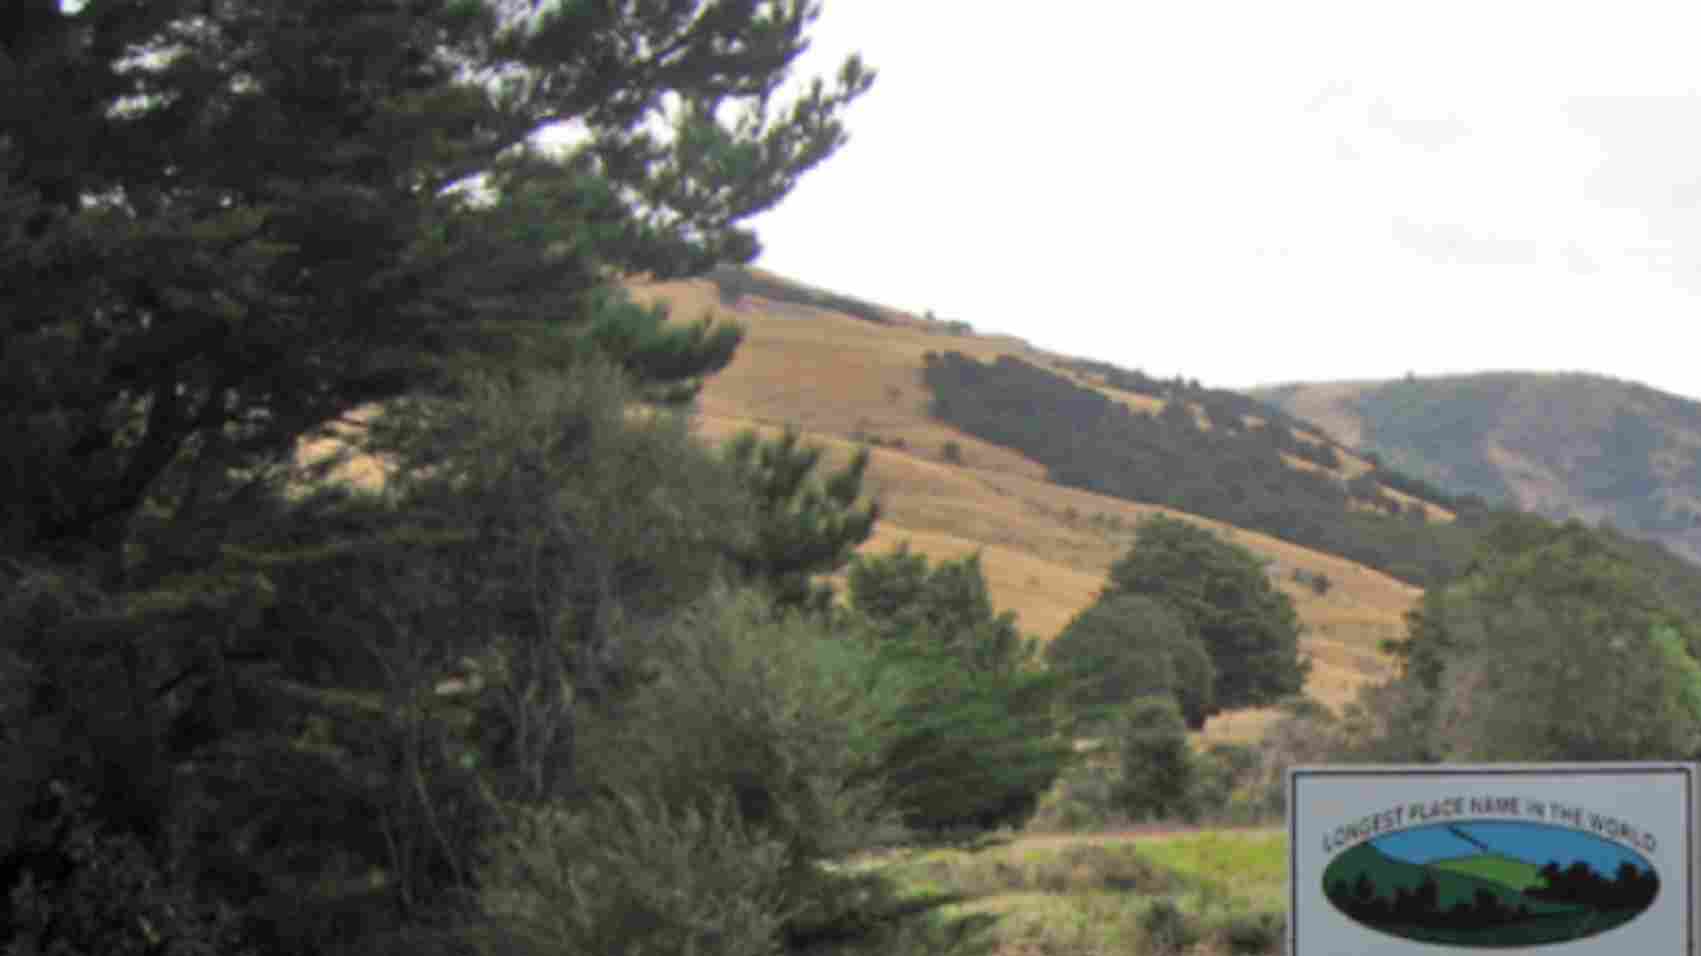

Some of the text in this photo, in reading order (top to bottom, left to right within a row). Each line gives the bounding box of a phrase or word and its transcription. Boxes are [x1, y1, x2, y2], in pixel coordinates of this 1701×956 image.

[1321, 797, 1658, 854] LONGEST PLACE NAME IN THE WORLD
